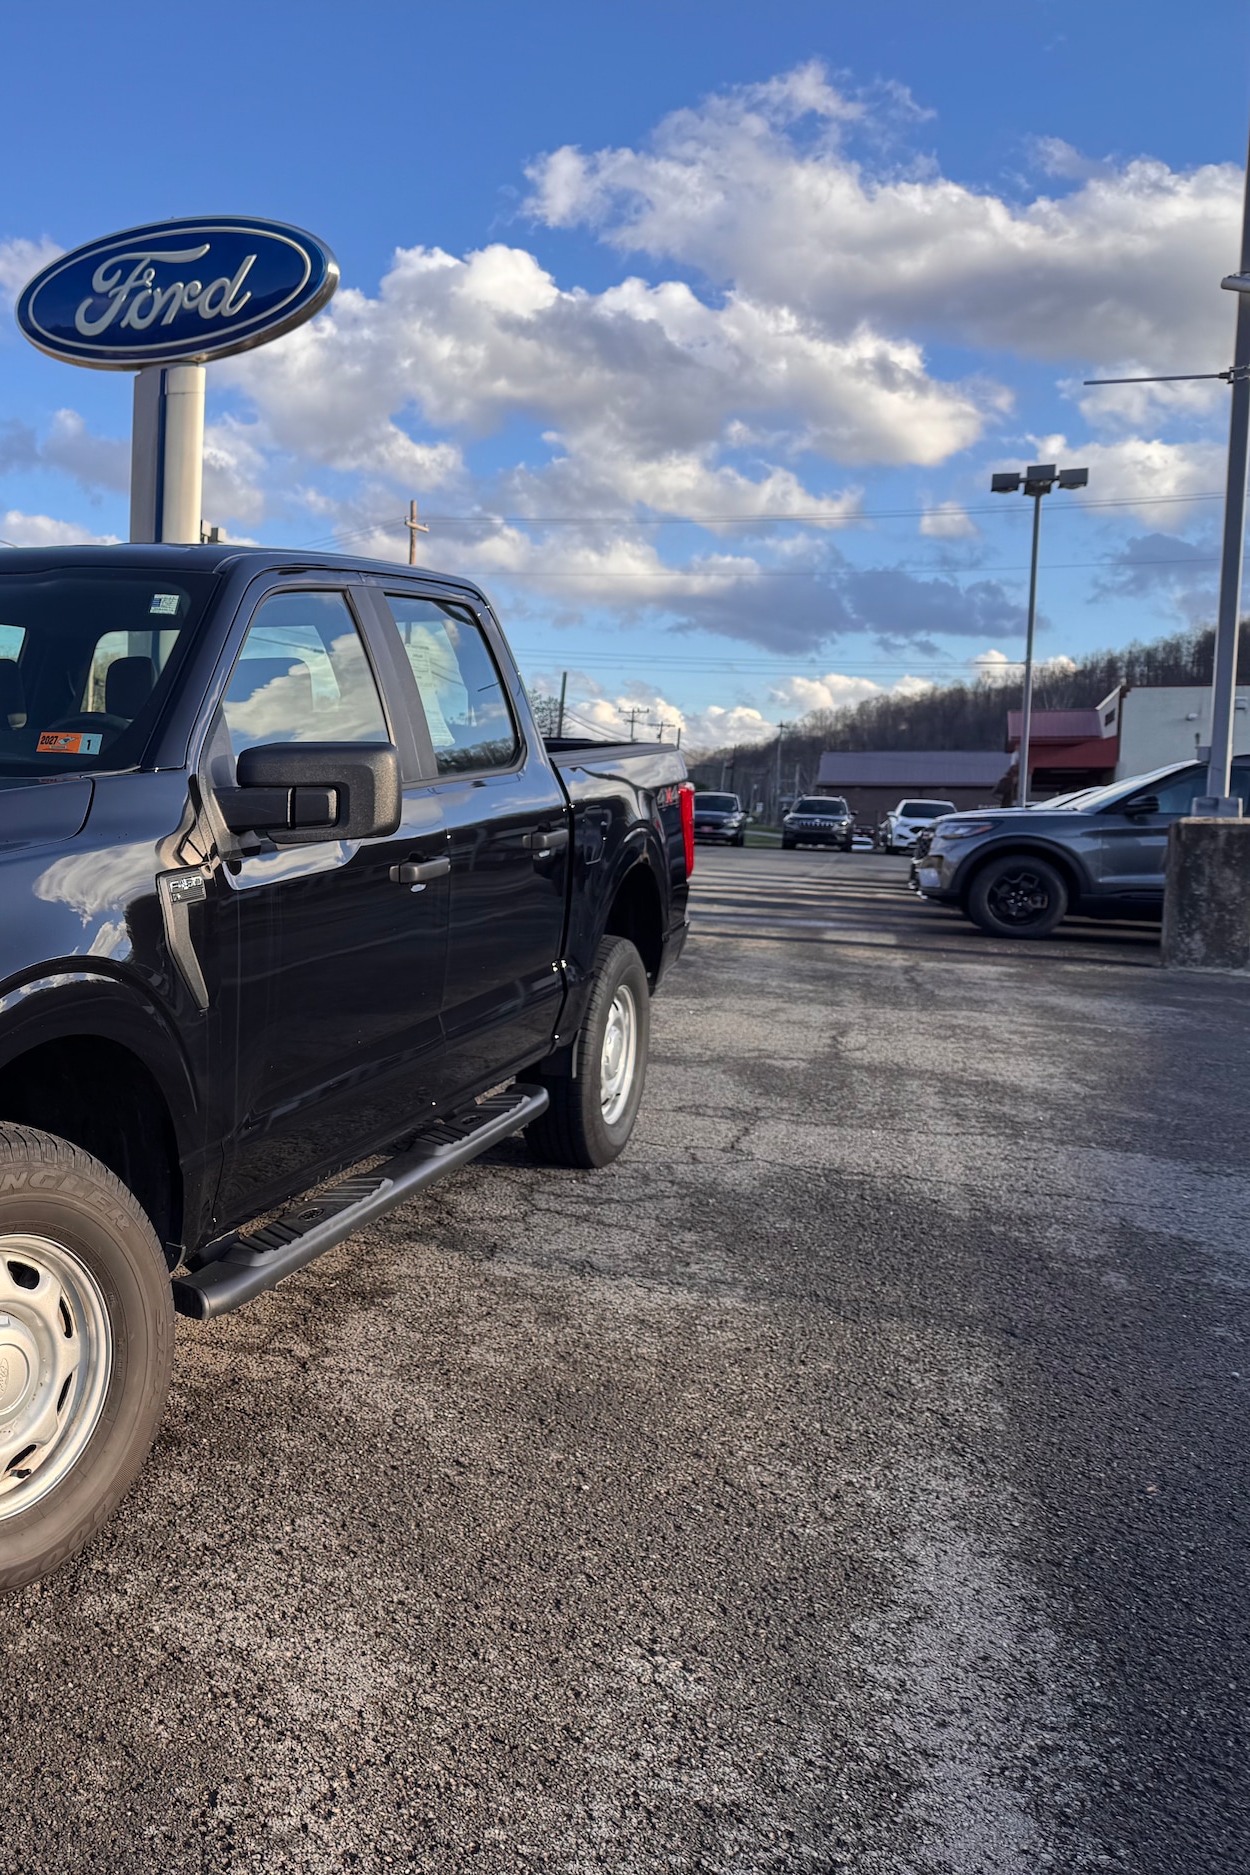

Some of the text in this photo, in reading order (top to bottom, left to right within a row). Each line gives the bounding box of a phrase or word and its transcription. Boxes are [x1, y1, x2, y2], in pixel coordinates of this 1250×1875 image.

[75, 242, 258, 337] Ford
[40, 735, 59, 745] 2027
[86, 739, 92, 751] 1
